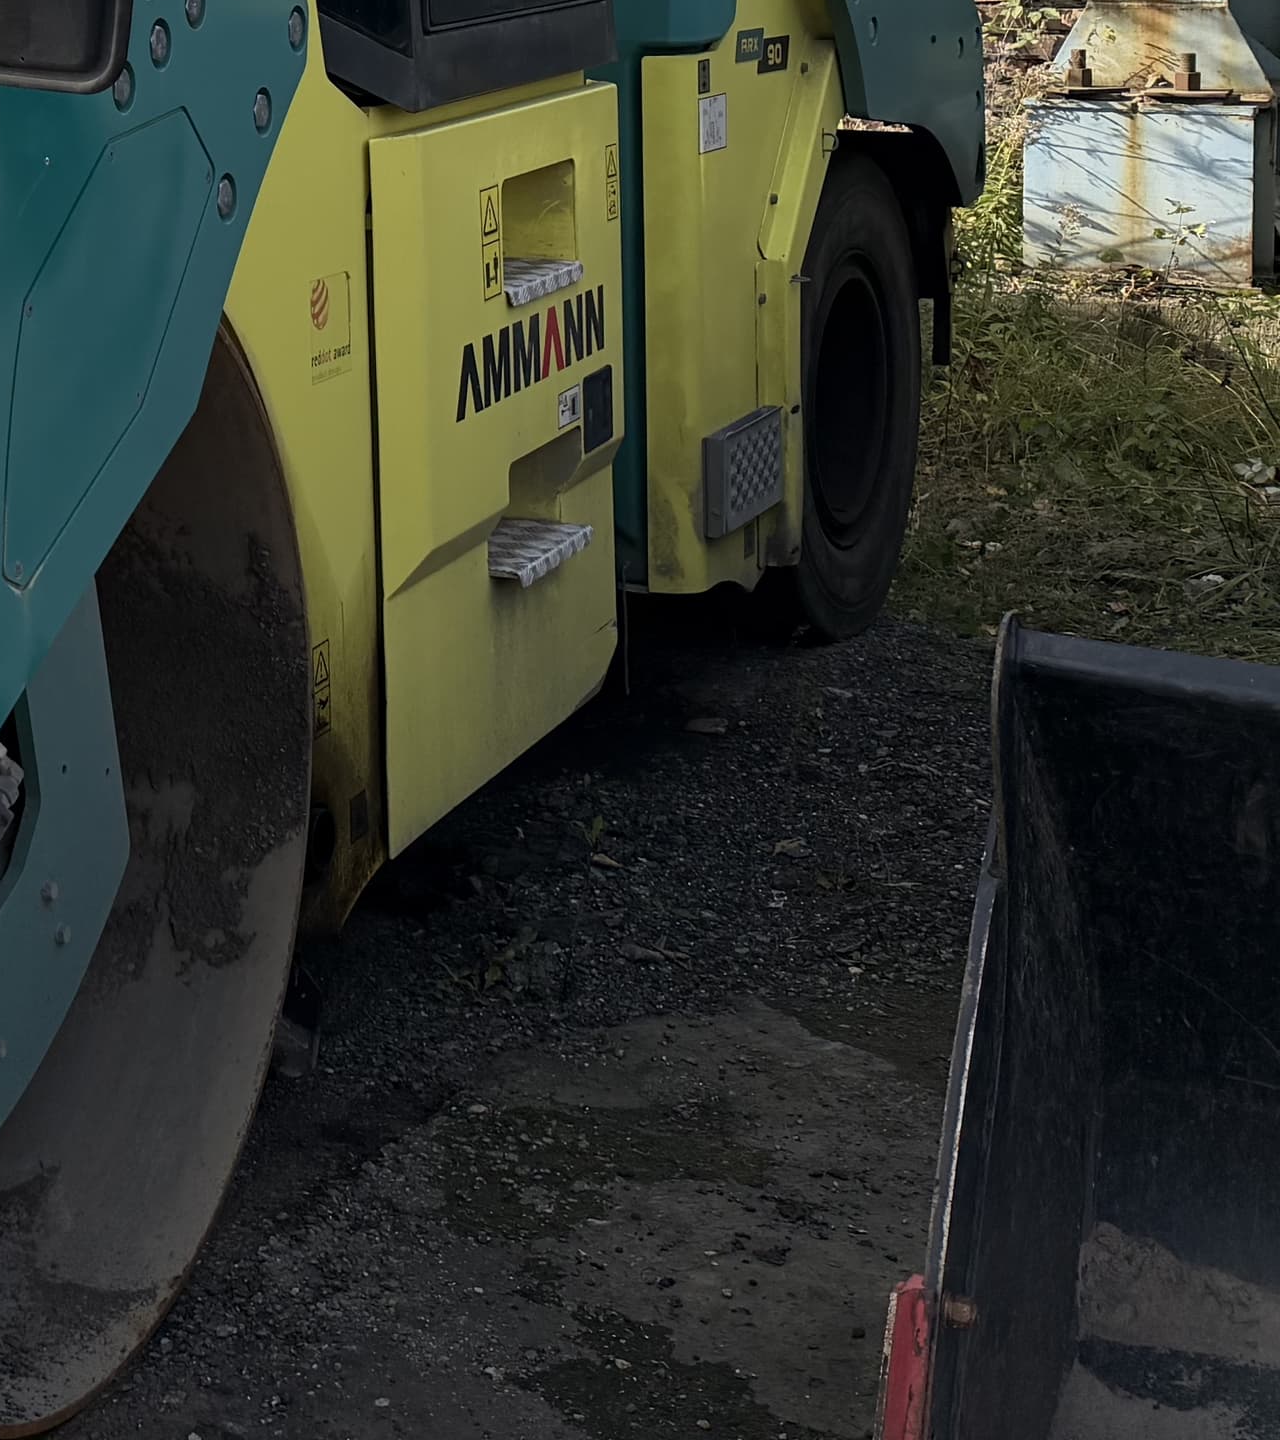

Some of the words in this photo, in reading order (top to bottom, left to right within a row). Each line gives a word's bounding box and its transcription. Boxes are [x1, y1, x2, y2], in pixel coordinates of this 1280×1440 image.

[741, 36, 759, 54] ARX
[767, 43, 782, 65] 90
[456, 284, 605, 423] AMMANN
